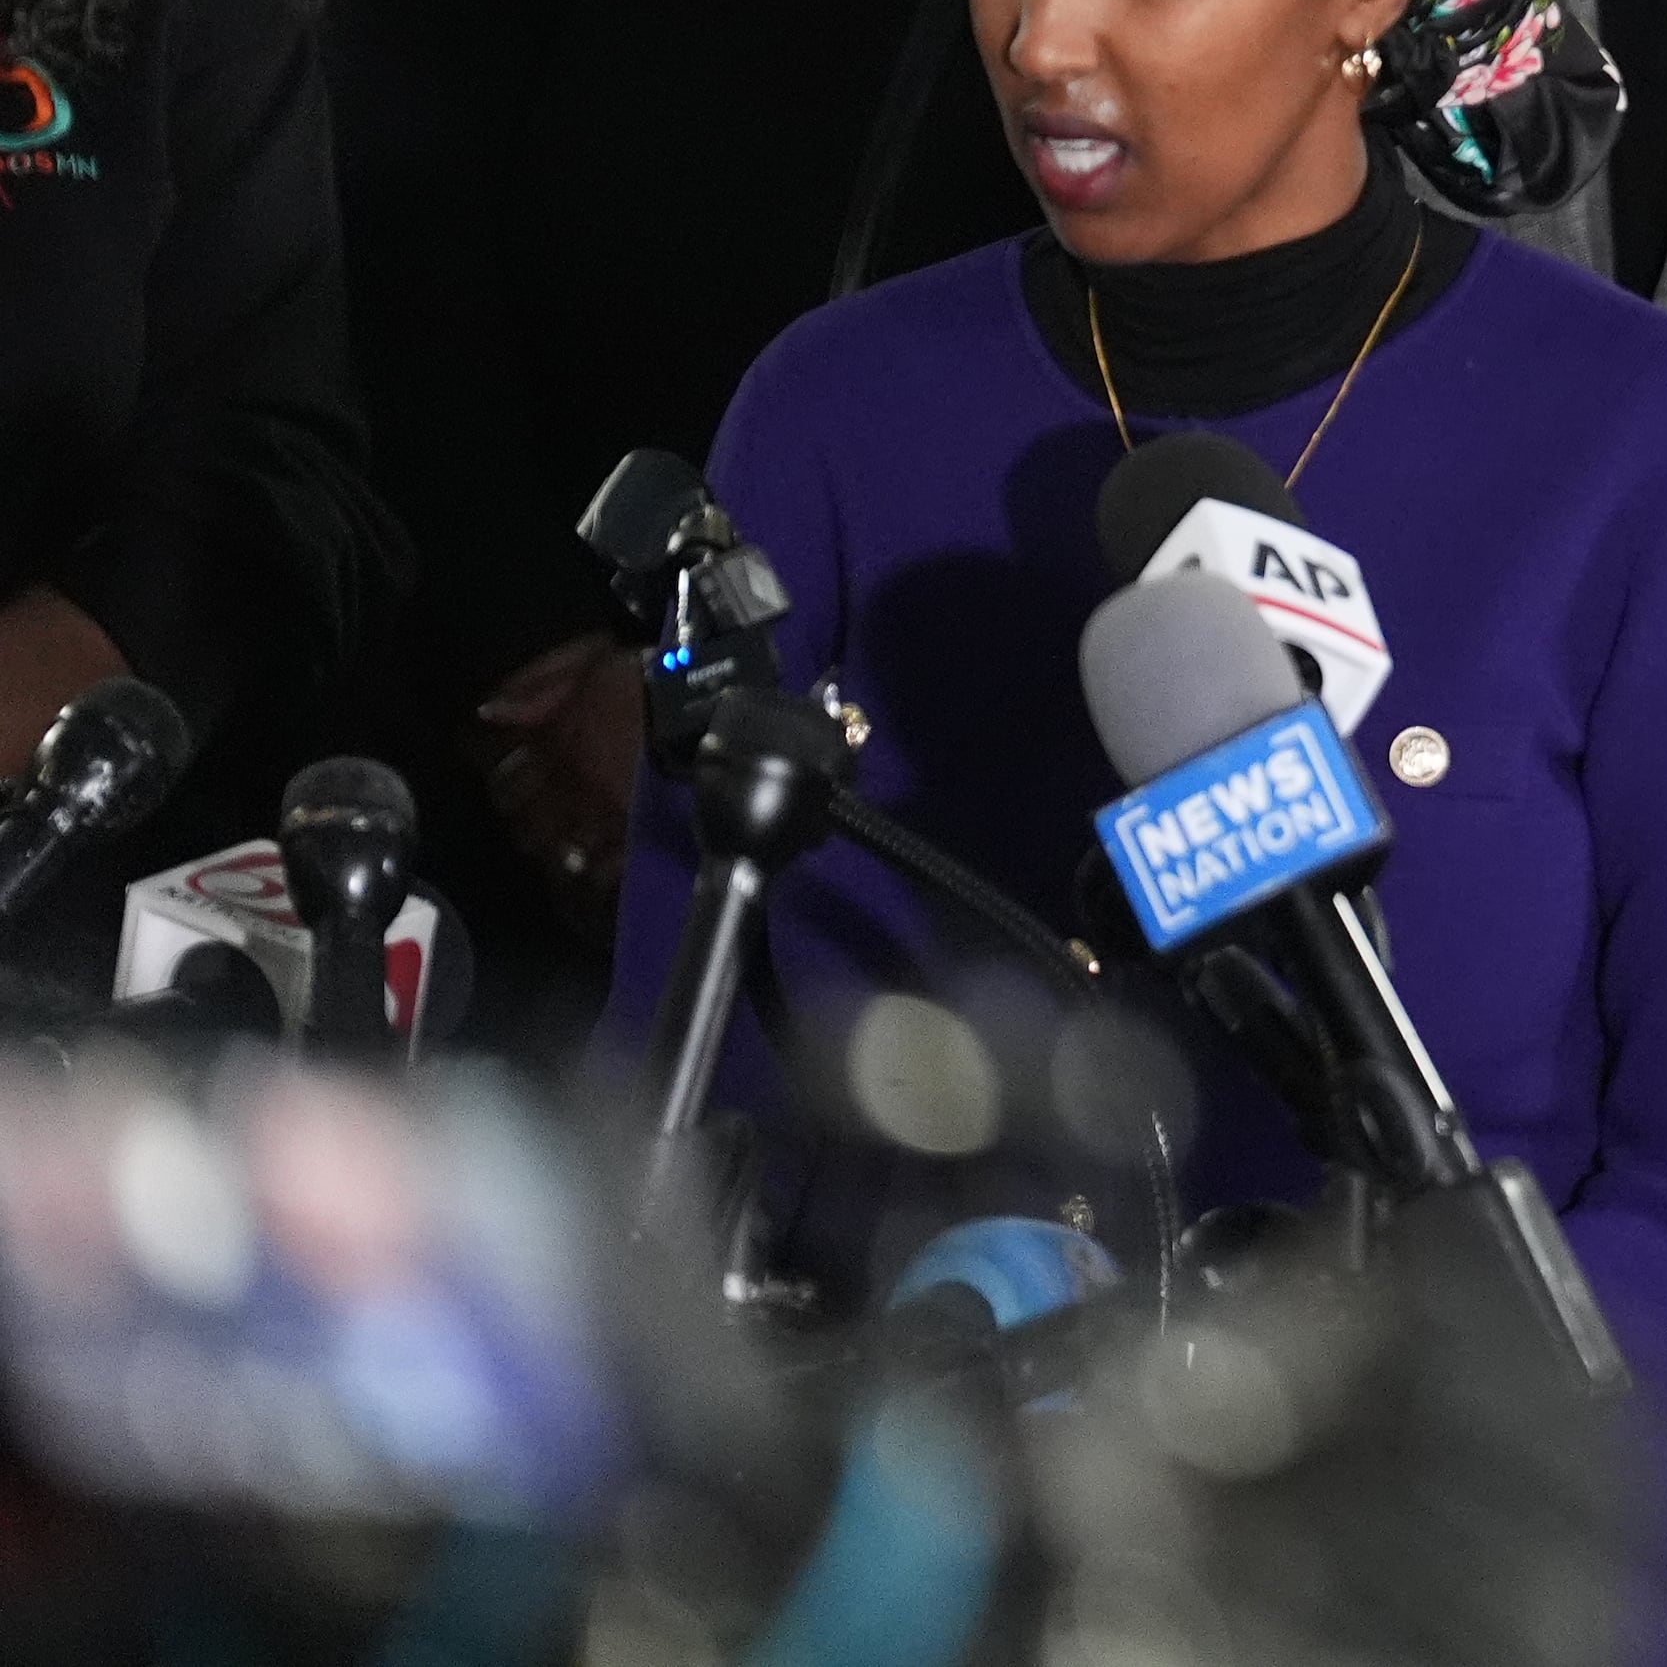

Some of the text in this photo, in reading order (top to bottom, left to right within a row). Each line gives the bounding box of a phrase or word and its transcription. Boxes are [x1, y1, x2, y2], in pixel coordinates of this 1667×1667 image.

[1254, 540, 1350, 602] AP
[1135, 745, 1314, 867] NEWS
[1158, 796, 1332, 907] NATION
